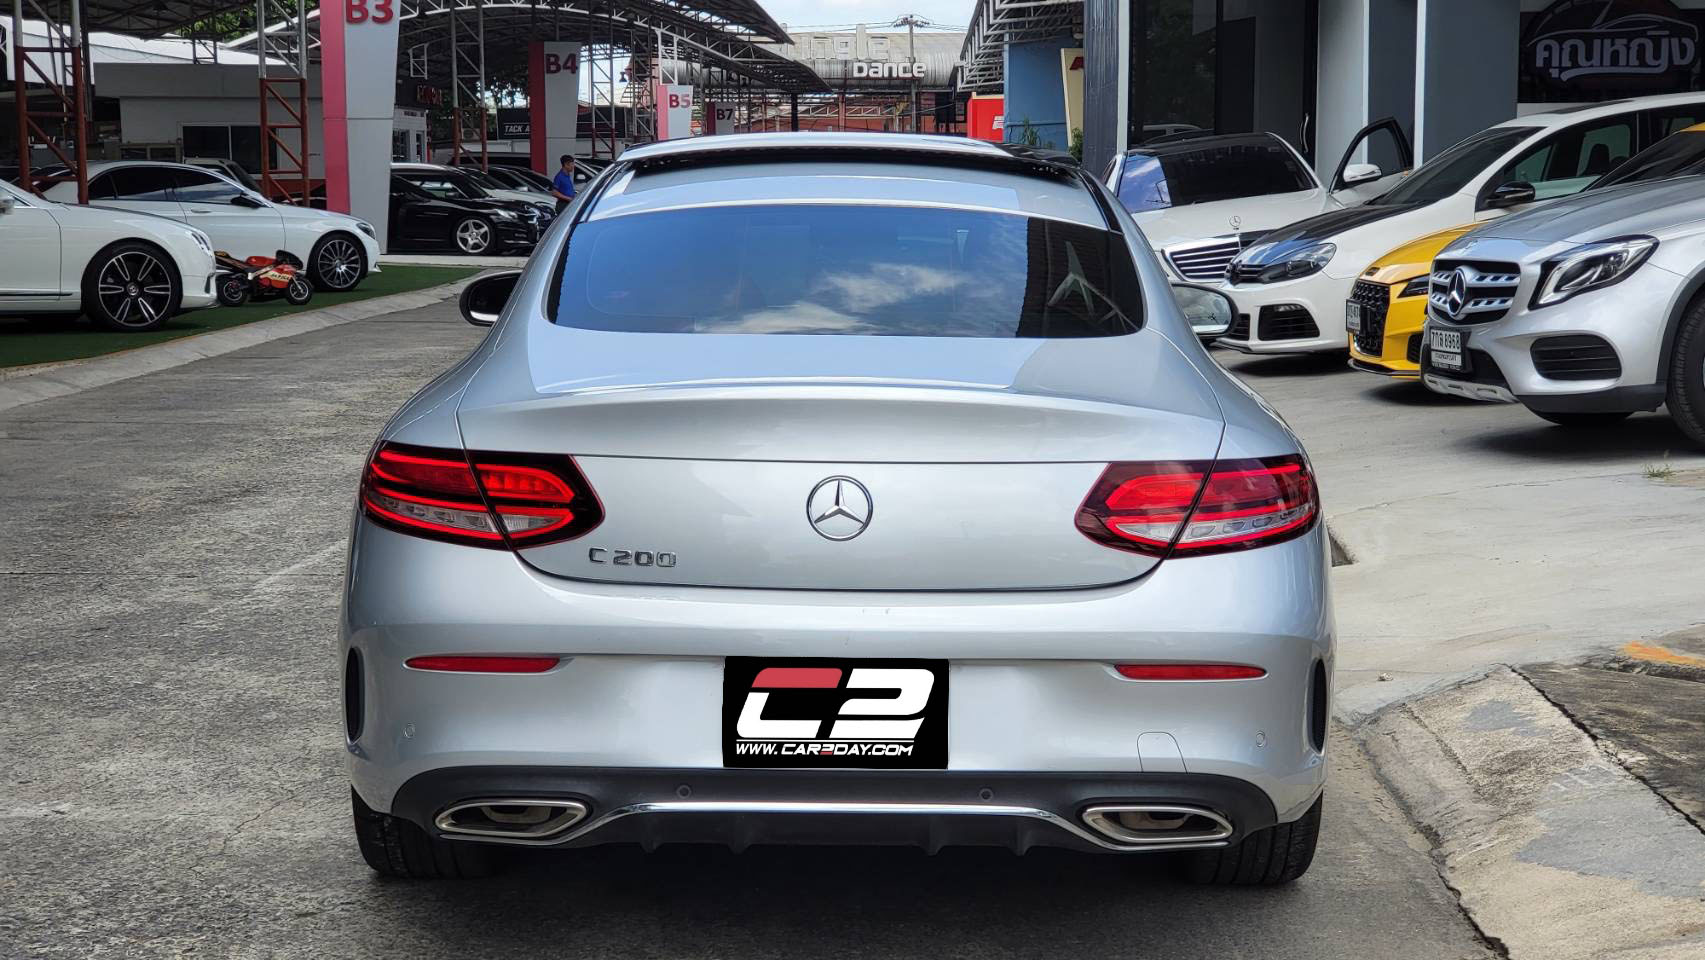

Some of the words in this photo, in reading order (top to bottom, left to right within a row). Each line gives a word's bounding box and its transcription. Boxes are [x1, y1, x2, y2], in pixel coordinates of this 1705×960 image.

[346, 0, 393, 24] B3
[545, 53, 578, 74] B4
[1536, 30, 1696, 82] คุณหญิง
[852, 62, 927, 78] Dance
[669, 93, 691, 109] B5
[716, 108, 734, 121] B7
[588, 547, 608, 563] C
[613, 549, 677, 567] 200
